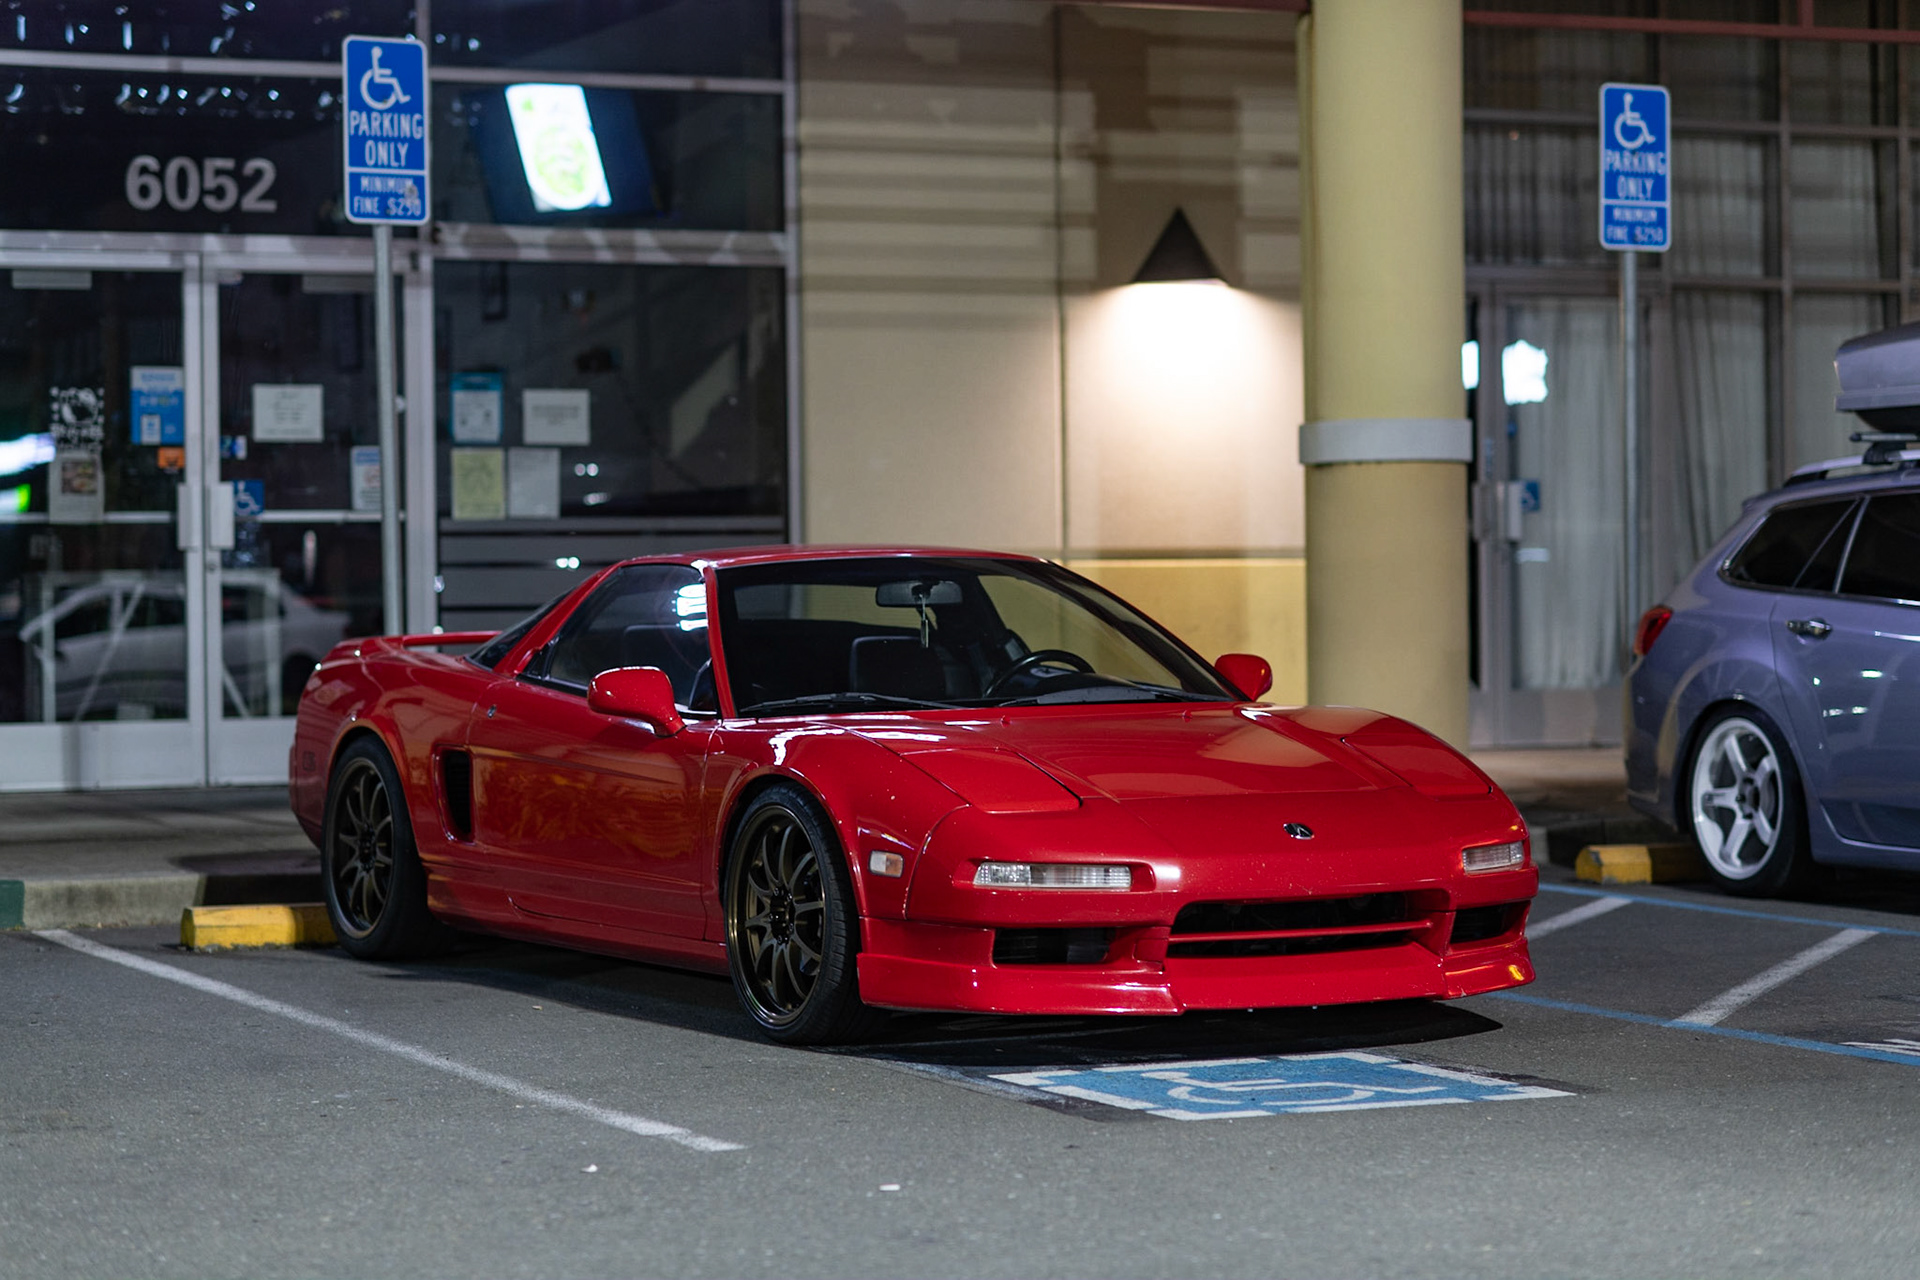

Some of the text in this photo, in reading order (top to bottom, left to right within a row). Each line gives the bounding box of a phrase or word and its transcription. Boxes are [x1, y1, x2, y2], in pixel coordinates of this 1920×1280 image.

[349, 110, 424, 139] PARKING
[365, 140, 409, 167] ONLY
[1605, 149, 1666, 175] PARKING
[125, 154, 278, 213] 6052
[1617, 175, 1654, 200] ONLY
[354, 196, 380, 214] FINE
